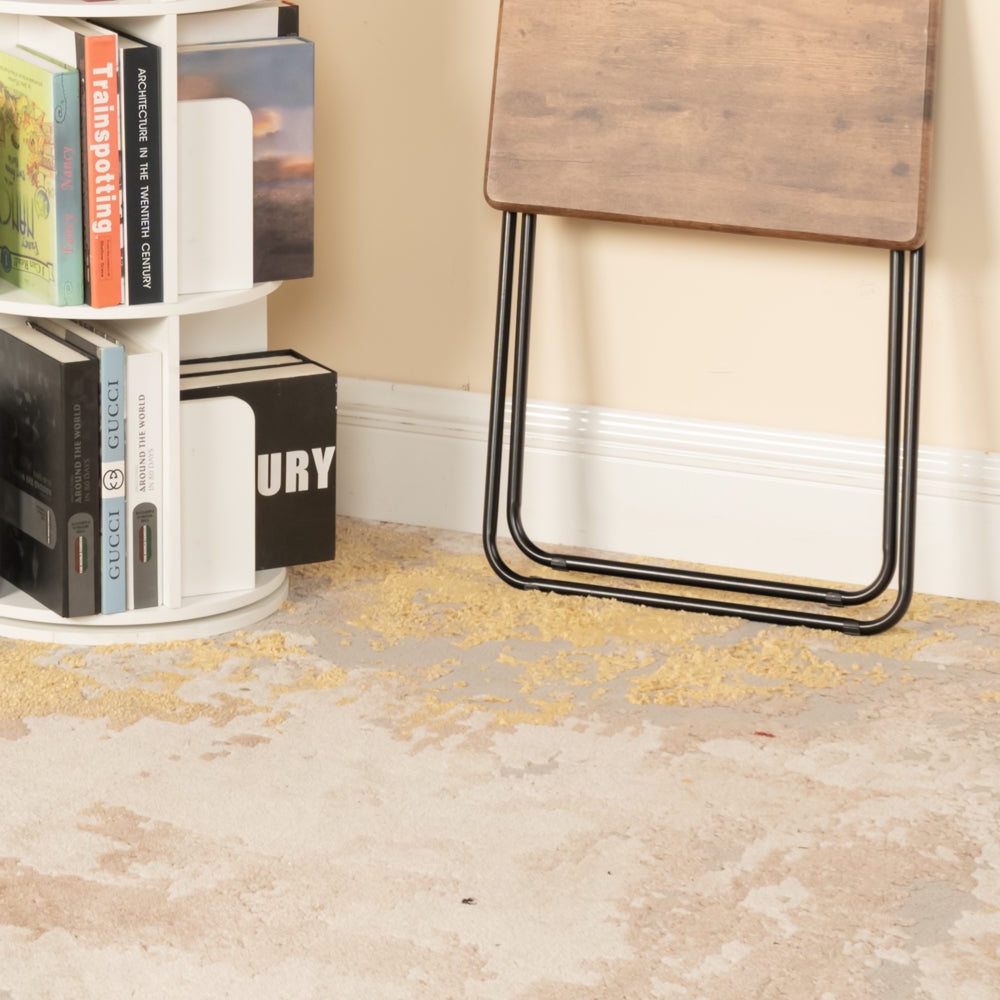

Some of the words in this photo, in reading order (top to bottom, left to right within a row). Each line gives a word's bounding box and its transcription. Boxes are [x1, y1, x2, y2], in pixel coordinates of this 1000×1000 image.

[137, 67, 148, 142] ARCHITECTURE
[60, 146, 76, 191] Nancy
[90, 62, 117, 234] Trainspotting
[139, 147, 148, 158] IN
[139, 162, 149, 180] THE
[61, 213, 78, 254] Fancy
[140, 185, 150, 238] TWENTIETH
[141, 242, 152, 289] CENTURY
[73, 403, 82, 439] WORLD
[108, 380, 119, 449] GUCCI
[138, 394, 146, 428] WORLD
[74, 440, 82, 458] THE
[138, 431, 146, 448] THE
[73, 461, 83, 504] AROUND
[257, 446, 336, 497] URY
[108, 510, 120, 580] GUCCI
